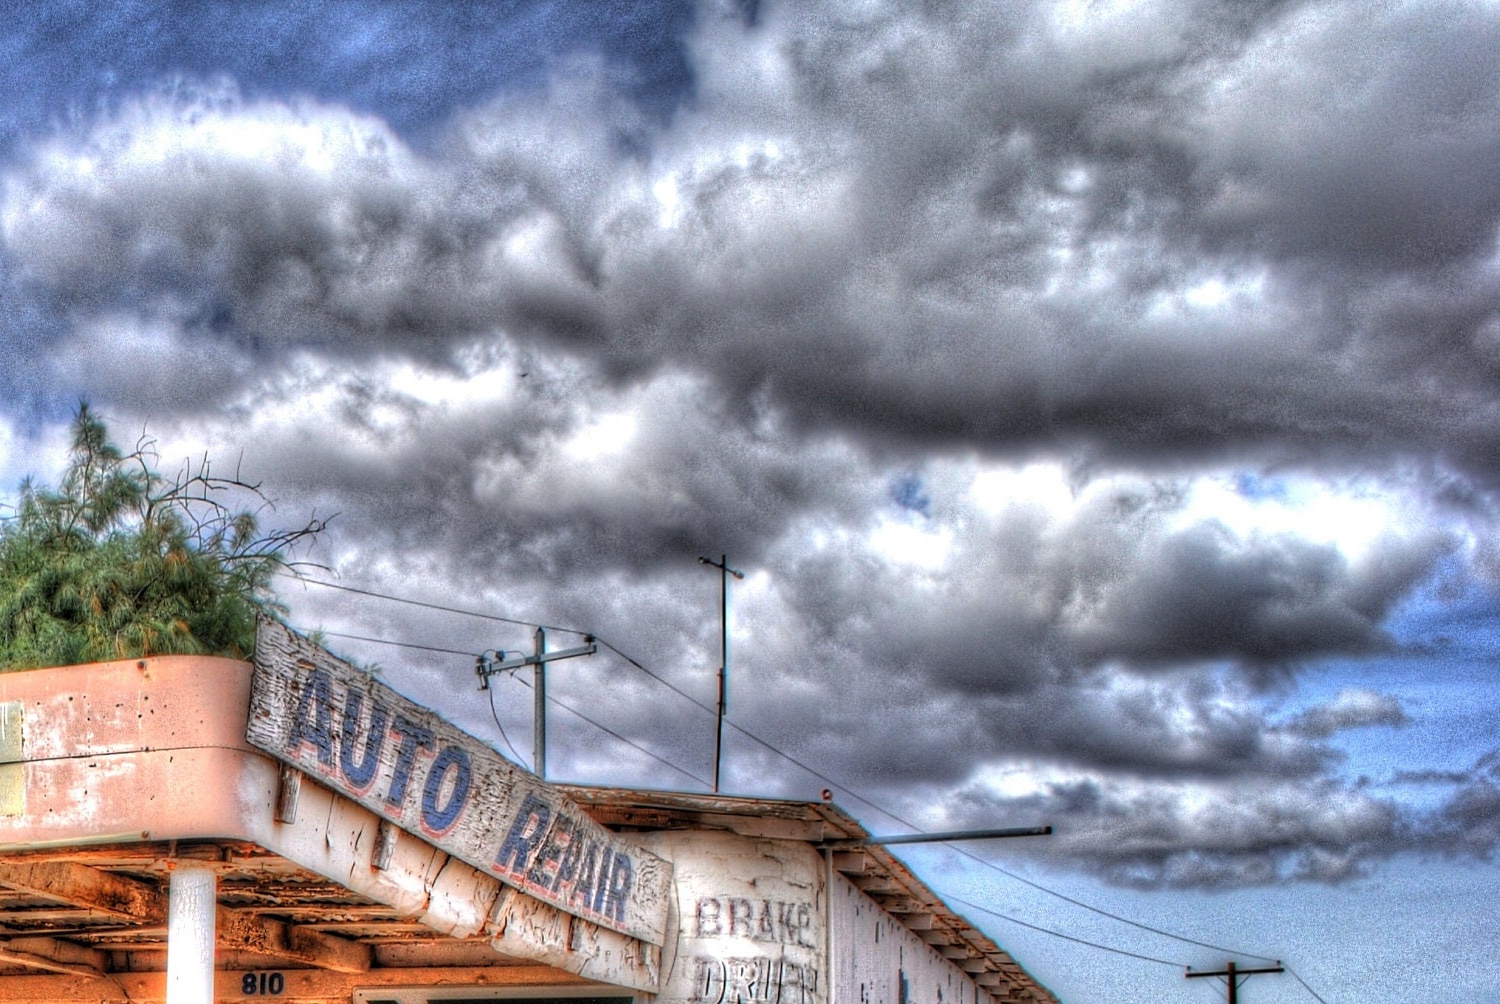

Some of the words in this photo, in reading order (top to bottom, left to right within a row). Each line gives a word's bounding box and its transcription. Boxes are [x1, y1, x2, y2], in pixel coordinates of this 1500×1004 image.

[289, 668, 473, 839] AUTO
[491, 791, 633, 930] REPAIR
[696, 897, 816, 950] BRAKE
[241, 972, 284, 995] 810
